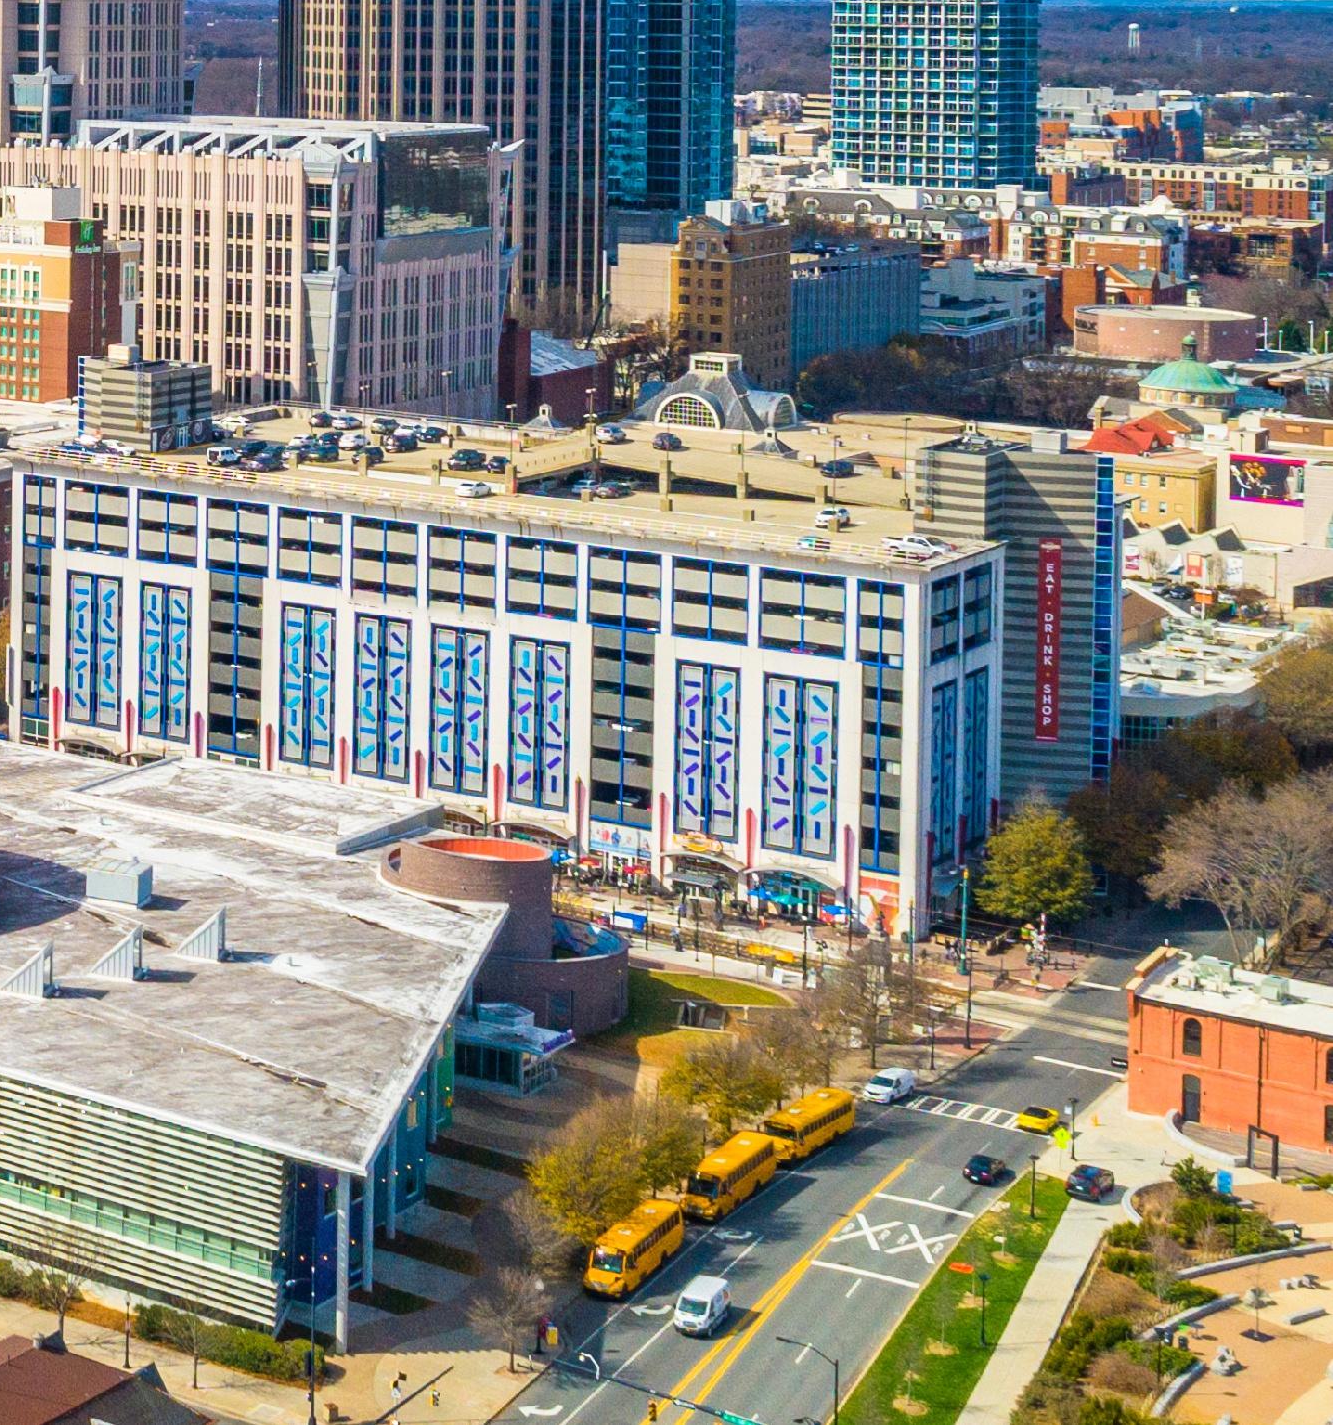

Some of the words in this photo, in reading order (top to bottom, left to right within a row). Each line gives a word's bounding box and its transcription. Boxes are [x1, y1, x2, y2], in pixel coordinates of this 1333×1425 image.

[1045, 563, 1055, 594] EAT
[1043, 613, 1054, 666] DRINK
[1041, 684, 1053, 726] SHOP
